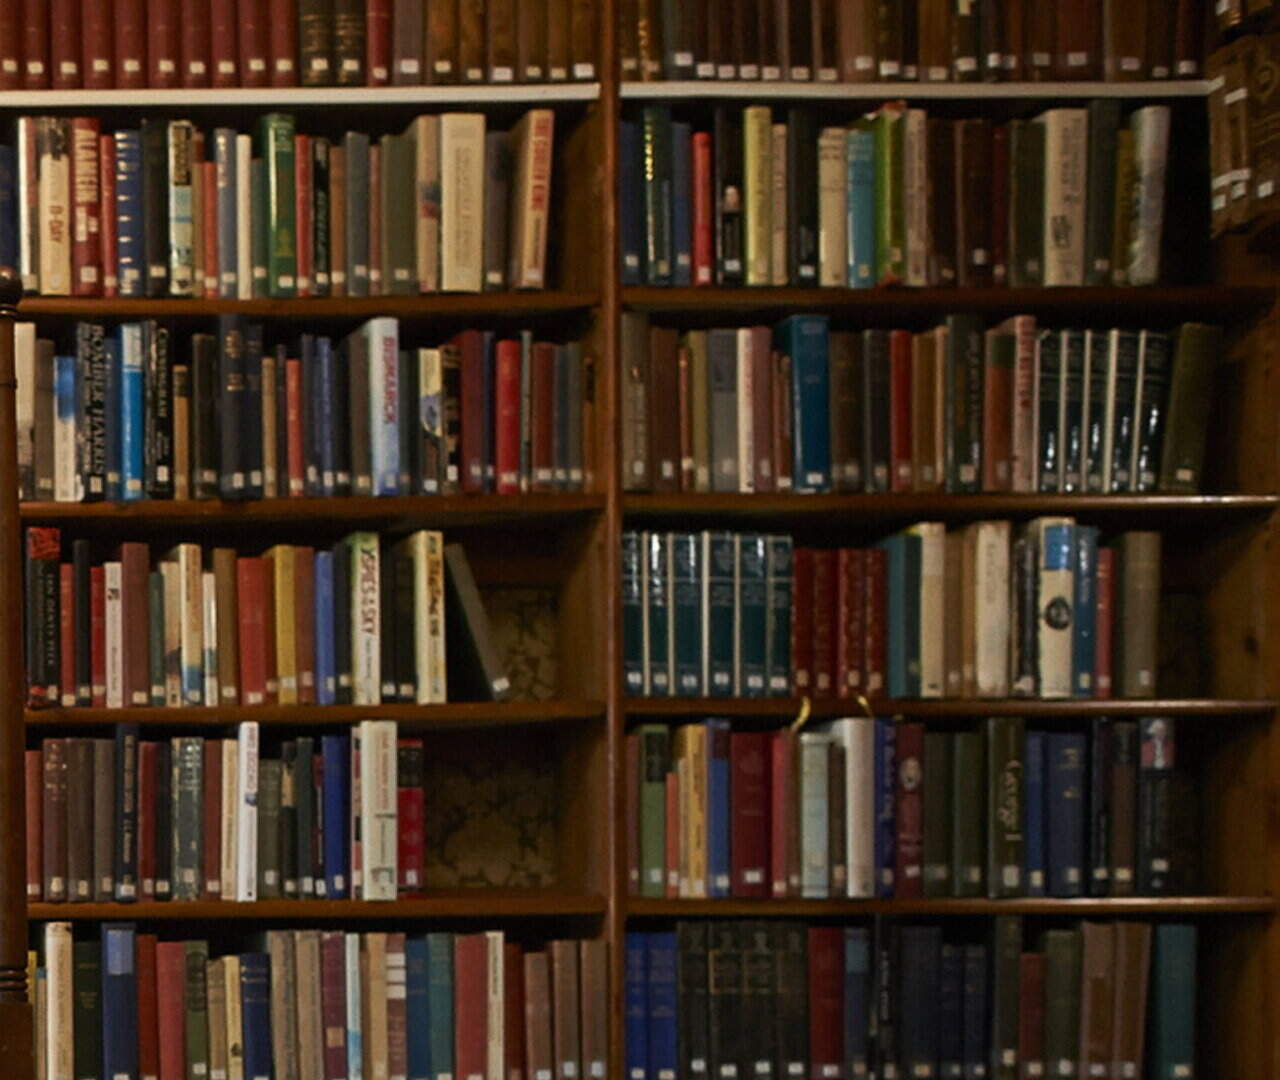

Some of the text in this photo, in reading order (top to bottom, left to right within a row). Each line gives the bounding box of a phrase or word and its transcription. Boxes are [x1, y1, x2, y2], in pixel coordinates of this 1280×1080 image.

[75, 129, 98, 203] ALAMEIN
[50, 206, 64, 243] D-DAY
[384, 337, 397, 424] BISMARCK
[93, 408, 106, 474] HARRIS
